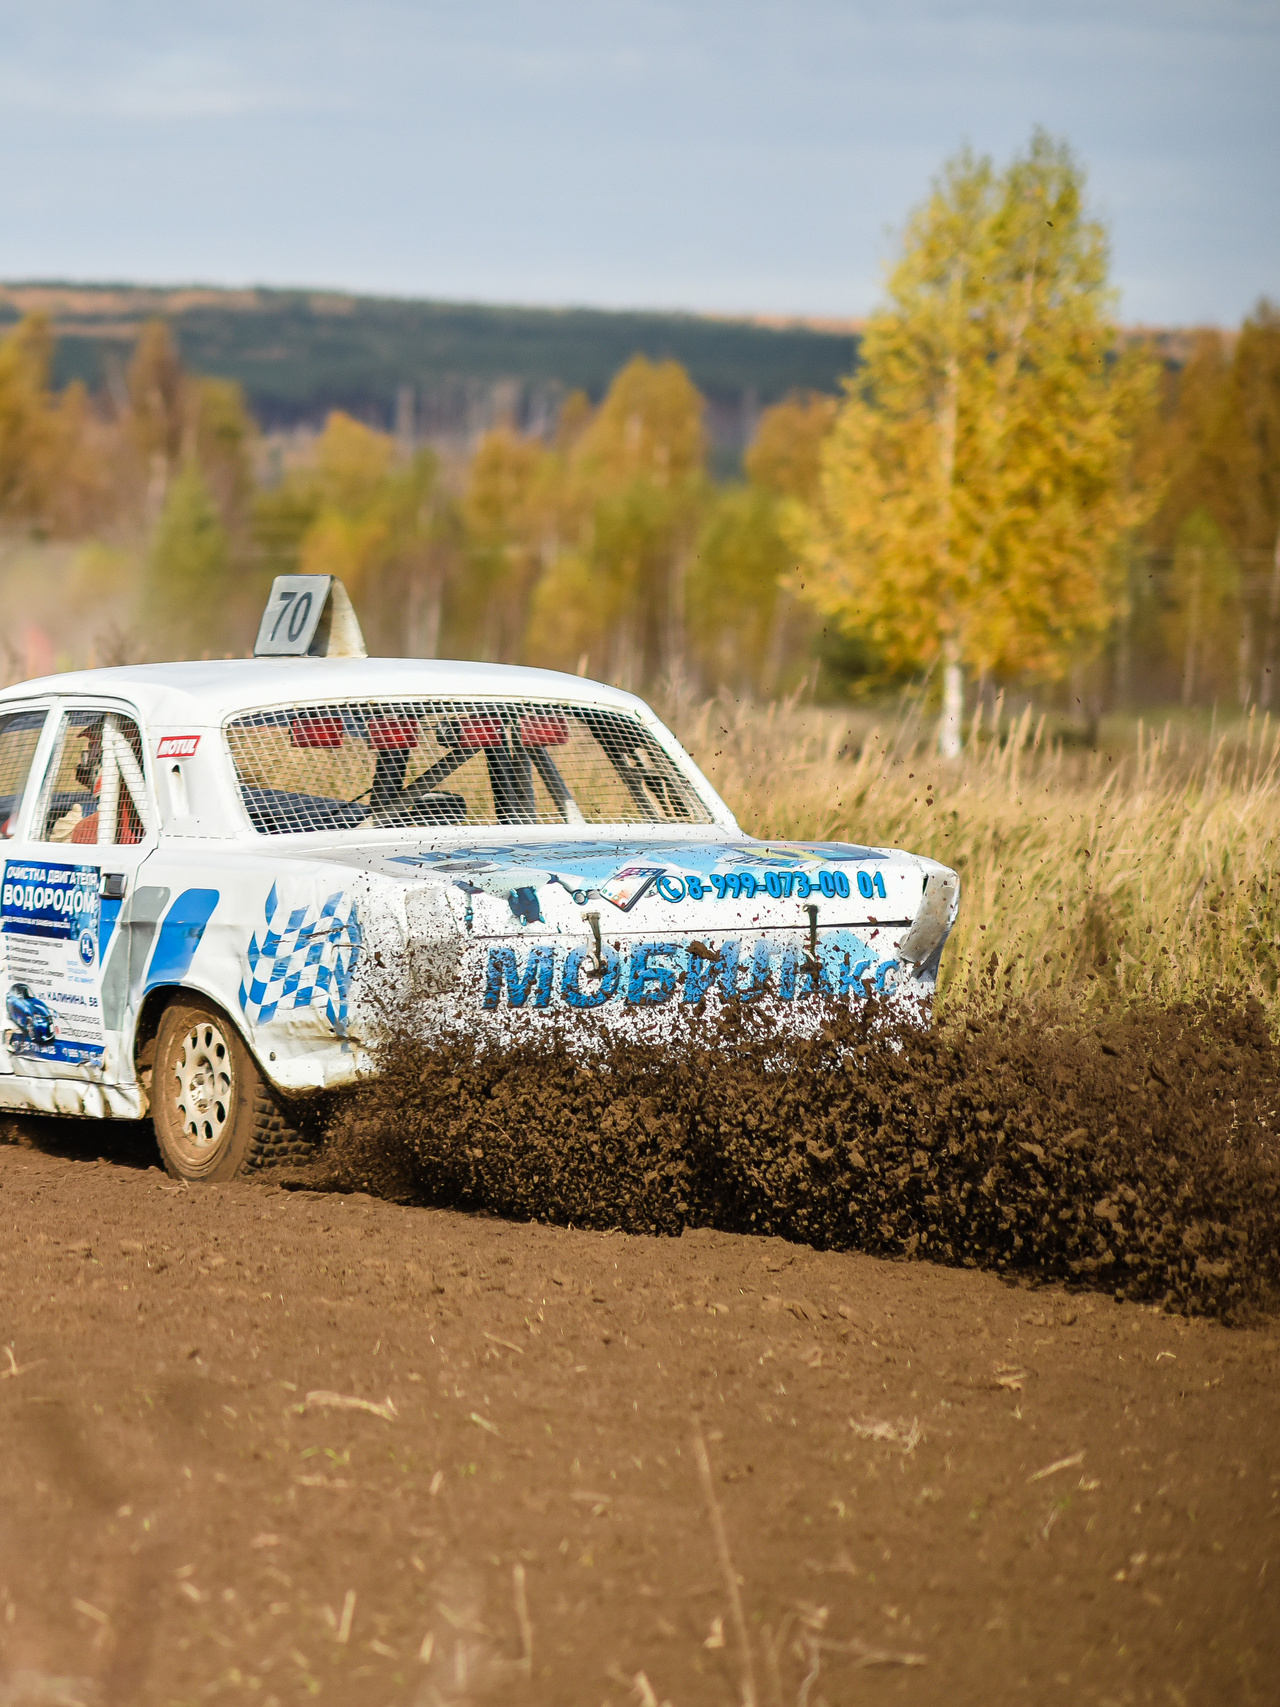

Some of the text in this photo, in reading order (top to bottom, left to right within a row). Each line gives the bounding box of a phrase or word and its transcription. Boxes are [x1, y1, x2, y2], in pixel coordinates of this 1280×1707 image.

[270, 591, 313, 642] 70
[157, 738, 197, 756] MOTUL
[6, 866, 46, 882] ОЧИСТКА
[685, 870, 887, 900] 8-999-073-00 01
[2, 884, 96, 915] ВОДОРОДОМ
